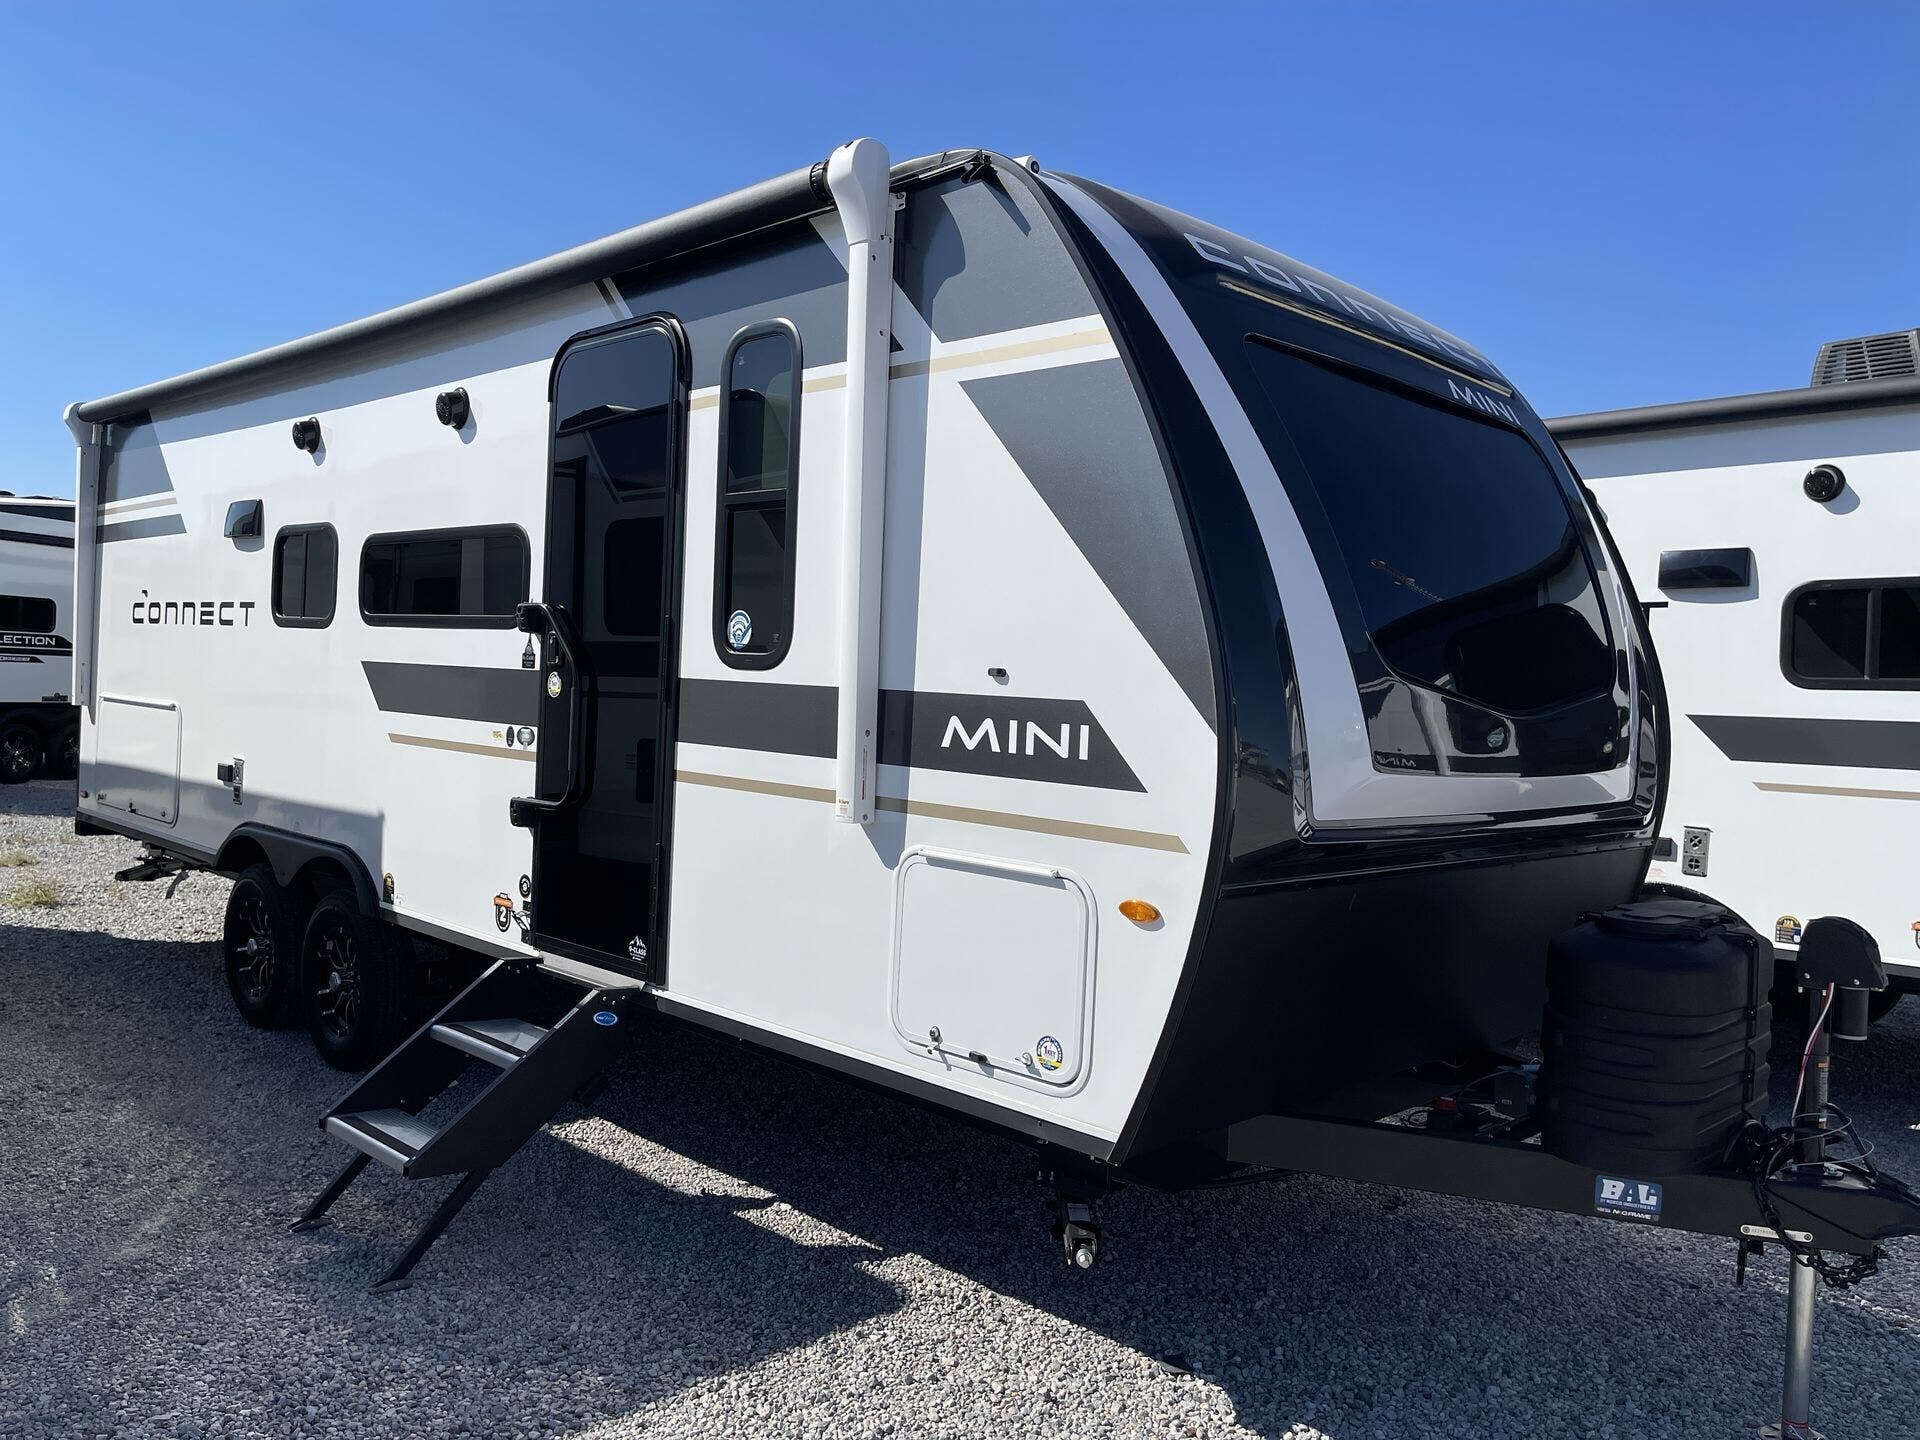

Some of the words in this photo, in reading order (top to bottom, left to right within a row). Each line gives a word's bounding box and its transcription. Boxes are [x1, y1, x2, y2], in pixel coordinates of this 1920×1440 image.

[1184, 233, 1502, 378] CONNECT
[1447, 379, 1521, 425] MINI
[133, 590, 255, 627] CONNECT
[0, 635, 56, 646] ECTION
[941, 715, 1089, 761] MINI
[1601, 1179, 1657, 1206] BAL
